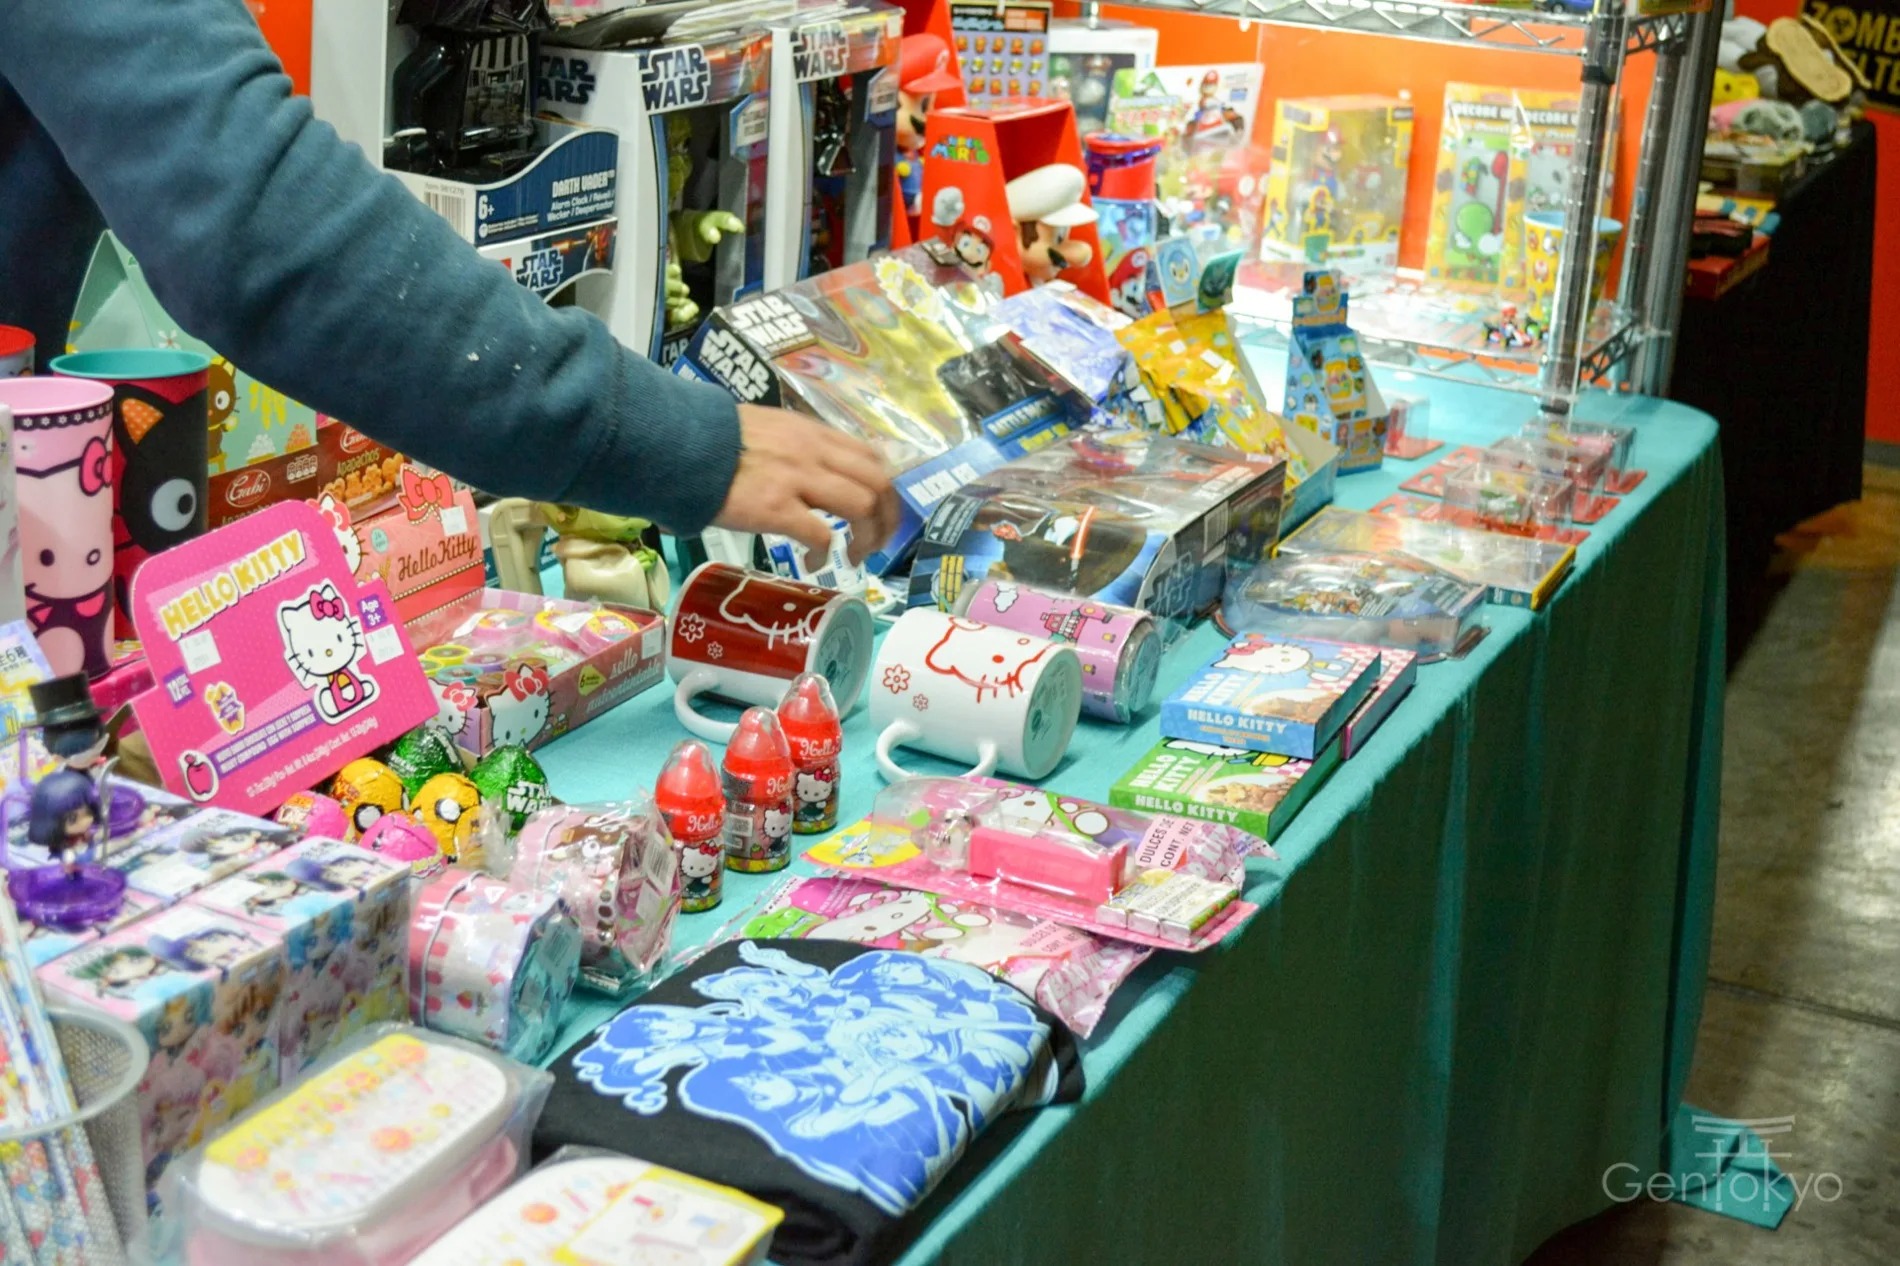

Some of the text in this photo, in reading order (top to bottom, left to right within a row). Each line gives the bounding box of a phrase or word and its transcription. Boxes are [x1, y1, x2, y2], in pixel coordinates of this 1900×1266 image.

[790, 28, 847, 52] STAR
[537, 55, 596, 82] TAR
[639, 47, 708, 83] STAR
[793, 47, 848, 79] WARS
[536, 78, 595, 105] ARS
[642, 74, 708, 111] WARS
[931, 143, 990, 165] MARIO
[552, 177, 580, 198] DARTH
[572, 194, 588, 207] Clock
[478, 195, 495, 220] 6+
[516, 249, 563, 275] STAR
[731, 295, 796, 329] STAR
[740, 313, 810, 347] WARS
[700, 335, 764, 401] WARS
[707, 329, 770, 399] STAR
[398, 537, 477, 582] Hello Kitty
[159, 528, 307, 641] HELLO KITTY
[360, 598, 380, 614] Age
[367, 613, 382, 627] 3+
[1181, 672, 1225, 702] HELLO
[1203, 674, 1247, 706] KITTY
[1187, 709, 1287, 734] HELLO KITTY
[1129, 754, 1177, 788] HELLO
[1153, 755, 1201, 792] KITTY
[1135, 794, 1239, 823] HELLO KITTY
[1178, 821, 1195, 836] NET
[1139, 828, 1168, 864] DULCES
